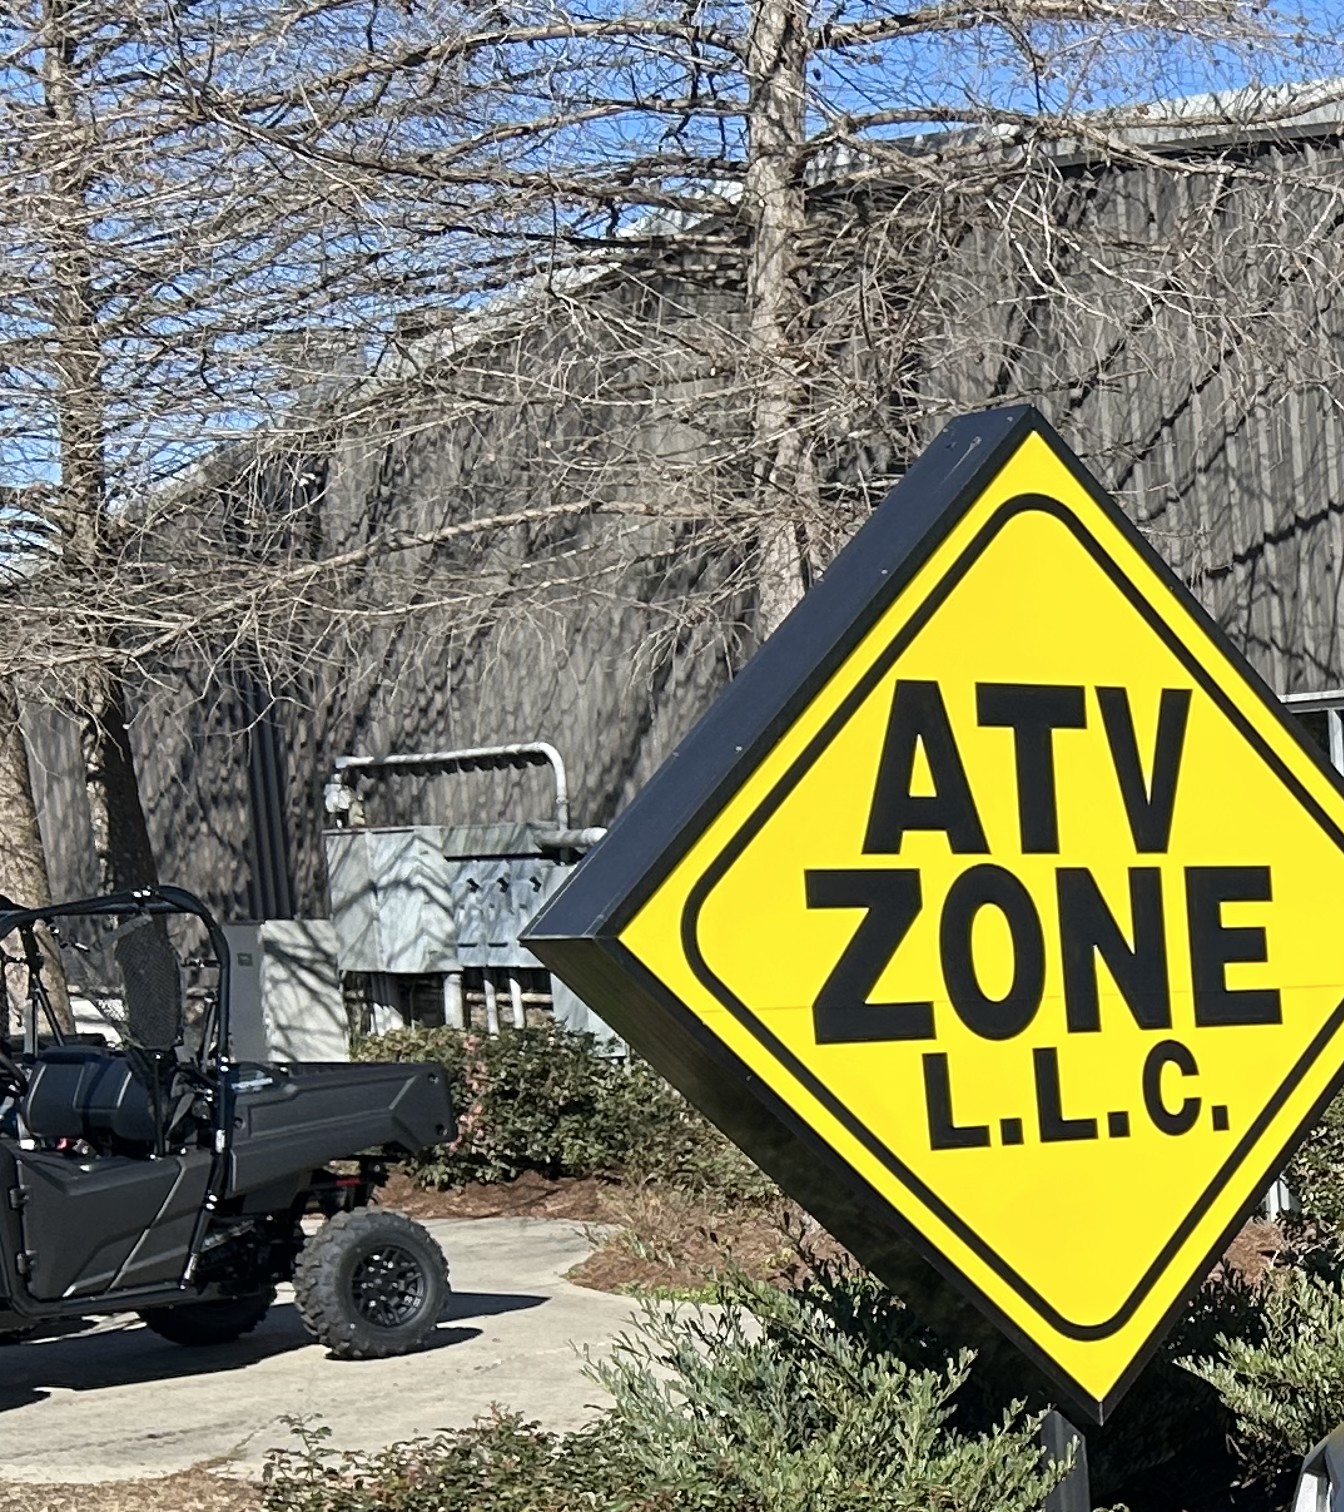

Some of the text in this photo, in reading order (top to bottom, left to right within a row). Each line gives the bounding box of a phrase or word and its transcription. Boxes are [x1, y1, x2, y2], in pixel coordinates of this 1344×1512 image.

[861, 679, 1193, 855] ATV
[804, 863, 1283, 1045] ZONE
[921, 1039, 1230, 1151] L.L.C.
